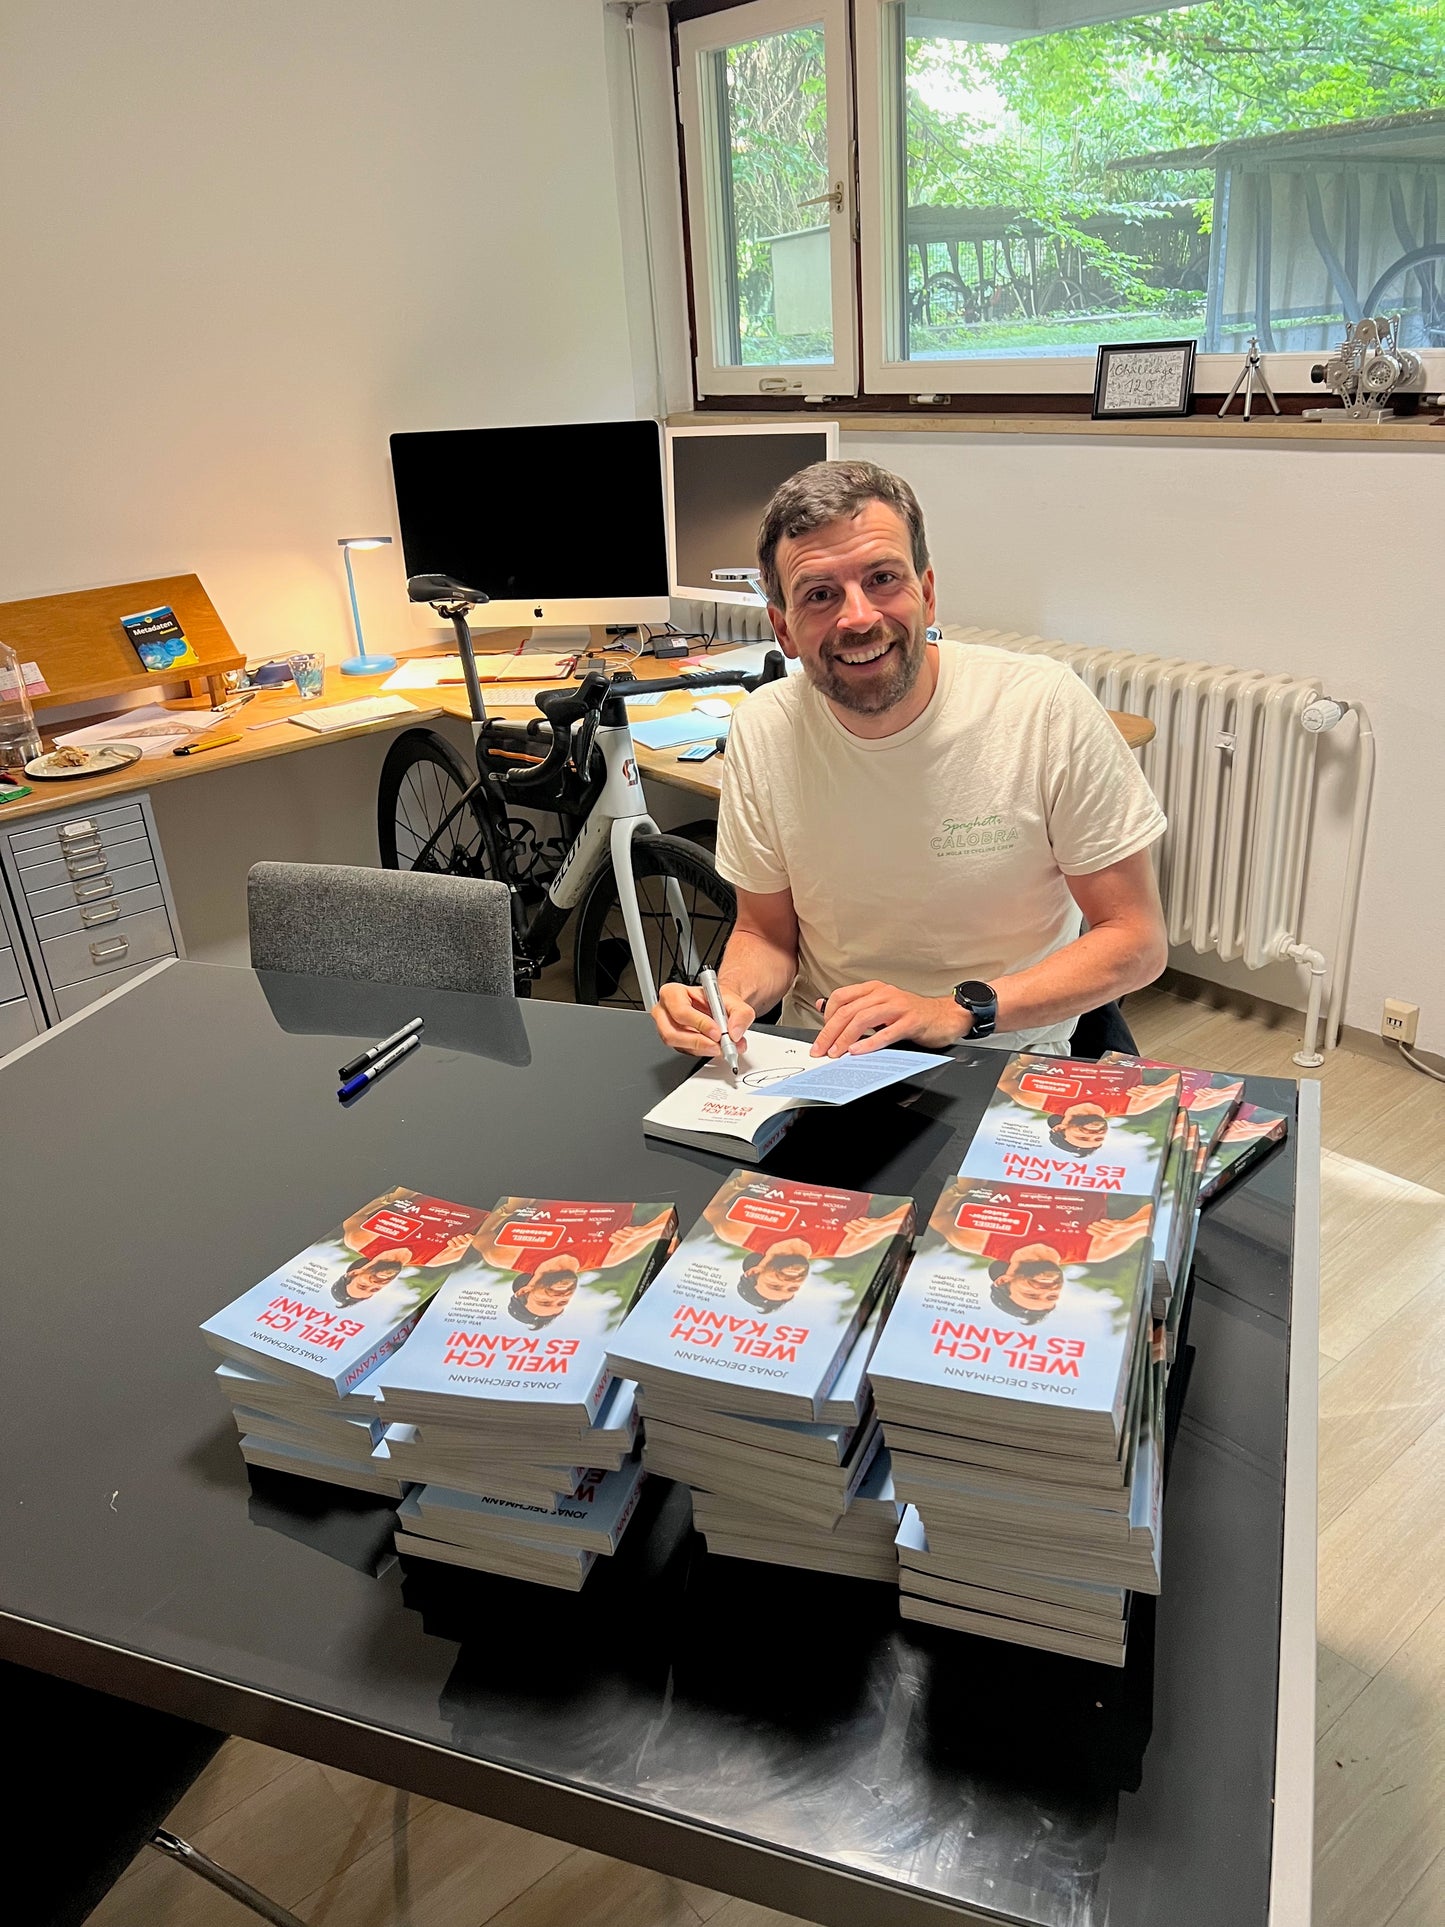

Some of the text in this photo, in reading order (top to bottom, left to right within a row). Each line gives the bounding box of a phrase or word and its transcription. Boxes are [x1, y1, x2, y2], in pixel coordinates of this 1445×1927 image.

[132, 621, 173, 636] Metadaten
[942, 815, 1002, 835] Spaghetti
[930, 827, 1019, 850] CALOBRA
[1003, 1153, 1126, 1178] ES KANN!
[1006, 1165, 1121, 1190] WEIL ICH
[744, 1211, 778, 1223] SPIEGEL
[972, 1220, 1011, 1230] SPIEGEL
[982, 1209, 1010, 1217] Autor
[512, 1234, 546, 1242] SPIEGEL
[924, 1298, 955, 1306] Mensch
[927, 1292, 964, 1301] Ironman-
[938, 1287, 978, 1297] Distanzen
[268, 1296, 365, 1337] ES KANN!
[673, 1305, 809, 1344] ES KANN!
[256, 1310, 346, 1351] WEIL ICH
[670, 1323, 796, 1362] WEIL ICH
[931, 1319, 1085, 1358] ES KANN!
[250, 1331, 327, 1363] JONAS DEICHMANN
[379, 1341, 391, 1356] ES
[445, 1331, 580, 1355] ES KANN!
[345, 1353, 378, 1386] KANN!
[443, 1349, 567, 1374] WEIL ICH
[674, 1350, 789, 1378] JONAS DEICHMANN
[933, 1338, 1079, 1377] WEIL ICH
[448, 1374, 561, 1389] JONAS DEICHMANN
[944, 1367, 1077, 1395] JONAS DEICHMANN
